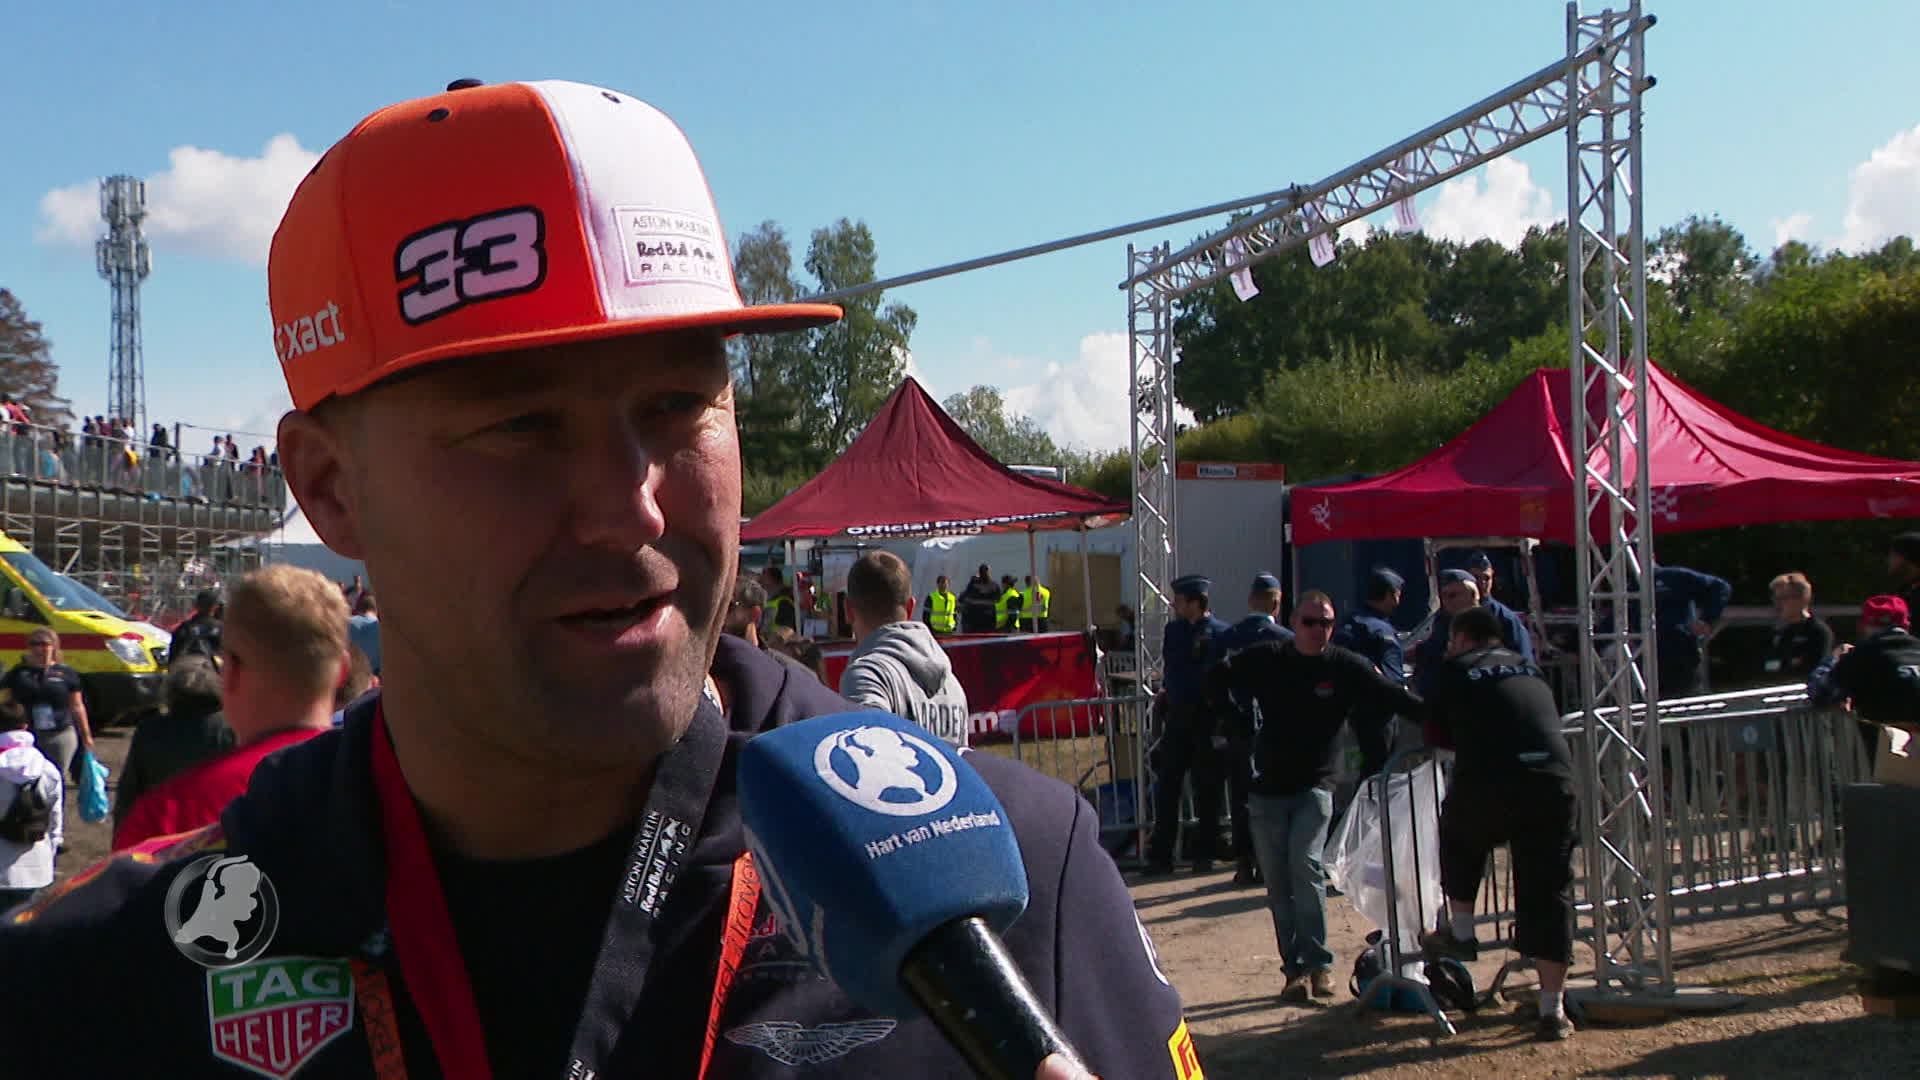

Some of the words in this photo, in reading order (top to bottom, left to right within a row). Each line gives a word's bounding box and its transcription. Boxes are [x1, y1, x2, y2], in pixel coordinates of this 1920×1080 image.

[394, 206, 547, 327] 33
[846, 521, 930, 536] Official
[623, 861, 645, 904] ASTON
[635, 809, 661, 860] MARTIN
[865, 833, 903, 859] Hart
[901, 825, 932, 845] van
[930, 809, 1001, 837] Nederland
[652, 823, 692, 918] RACING
[220, 965, 342, 1010] TAG
[219, 1005, 343, 1071] HEUER
